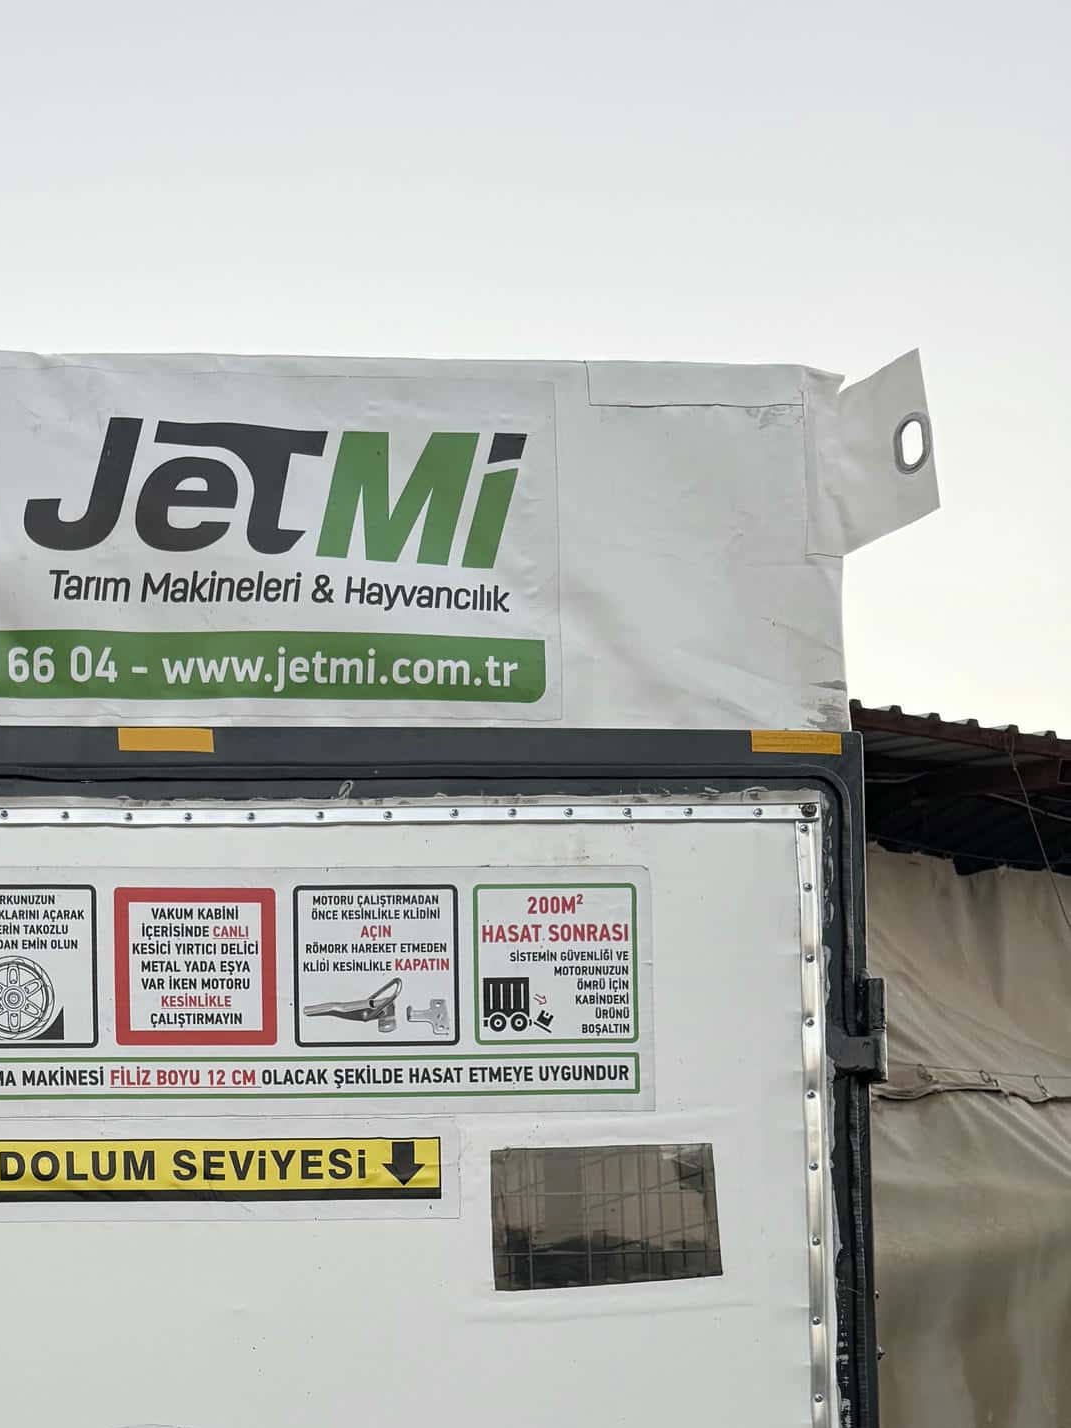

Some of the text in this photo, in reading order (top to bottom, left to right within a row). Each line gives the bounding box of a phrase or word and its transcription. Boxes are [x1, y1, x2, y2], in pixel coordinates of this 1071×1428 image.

[49, 569, 510, 613] Tarım Makineleri & Hayvancılık
[7, 643, 56, 684] 66
[69, 643, 119, 684] 04
[162, 647, 519, 691] www.jetmi.com.tr
[313, 895, 439, 907] MOTORU ÇALIŞTIRMADAN
[43, 910, 84, 922] AÇARAK
[151, 906, 239, 920] VAKUM KABİNİ
[312, 907, 440, 920] ÖNCE KESİNLİKLE KLİDİNİ
[23, 925, 68, 935] TAKOZLU
[142, 923, 249, 940] İÇERİSİNDE CANLI
[360, 925, 392, 940] AÇIN
[481, 924, 629, 943] HASAT SONRASI
[22, 938, 47, 949] EMİN
[51, 940, 78, 950] OLUN
[132, 941, 258, 955] KESİCİ YIRTICI DELİCİ
[306, 942, 447, 954] RÖMORK HAREKET ETMEDEN
[510, 949, 629, 962] SİSTEMİN GÜVENLİĞİ VE
[141, 961, 250, 975] METAL YADA EŞYA
[303, 958, 449, 972] KLİDİ KESİNLİKLE KAPATIN
[554, 966, 629, 976] MOTORUNUZUN
[142, 976, 250, 990] VAR İKEN MOTORU
[577, 978, 629, 992] ÖMRÜ İÇİN
[161, 993, 231, 1007] KESİNLİKLE
[576, 993, 629, 1004] KABİNDEKİ
[595, 1007, 629, 1019] ÜRÜNÜ
[151, 1013, 242, 1028] ÇALIŞTIRMAYIN
[582, 1024, 630, 1036] BOŞALTIN
[22, 1066, 104, 1087] MAKİNESİ
[110, 1066, 151, 1087] FİLİZ
[157, 1069, 201, 1085] BOYU
[208, 1070, 226, 1085] 12
[231, 1069, 256, 1085] CM
[262, 1068, 329, 1085] OLACAK
[335, 1065, 404, 1088] ŞEKİLDE
[409, 1067, 463, 1084] HASAT
[469, 1066, 534, 1084] ETMEYE
[539, 1065, 630, 1082] UYGUNDUR
[0, 1149, 157, 1182] DOLUM
